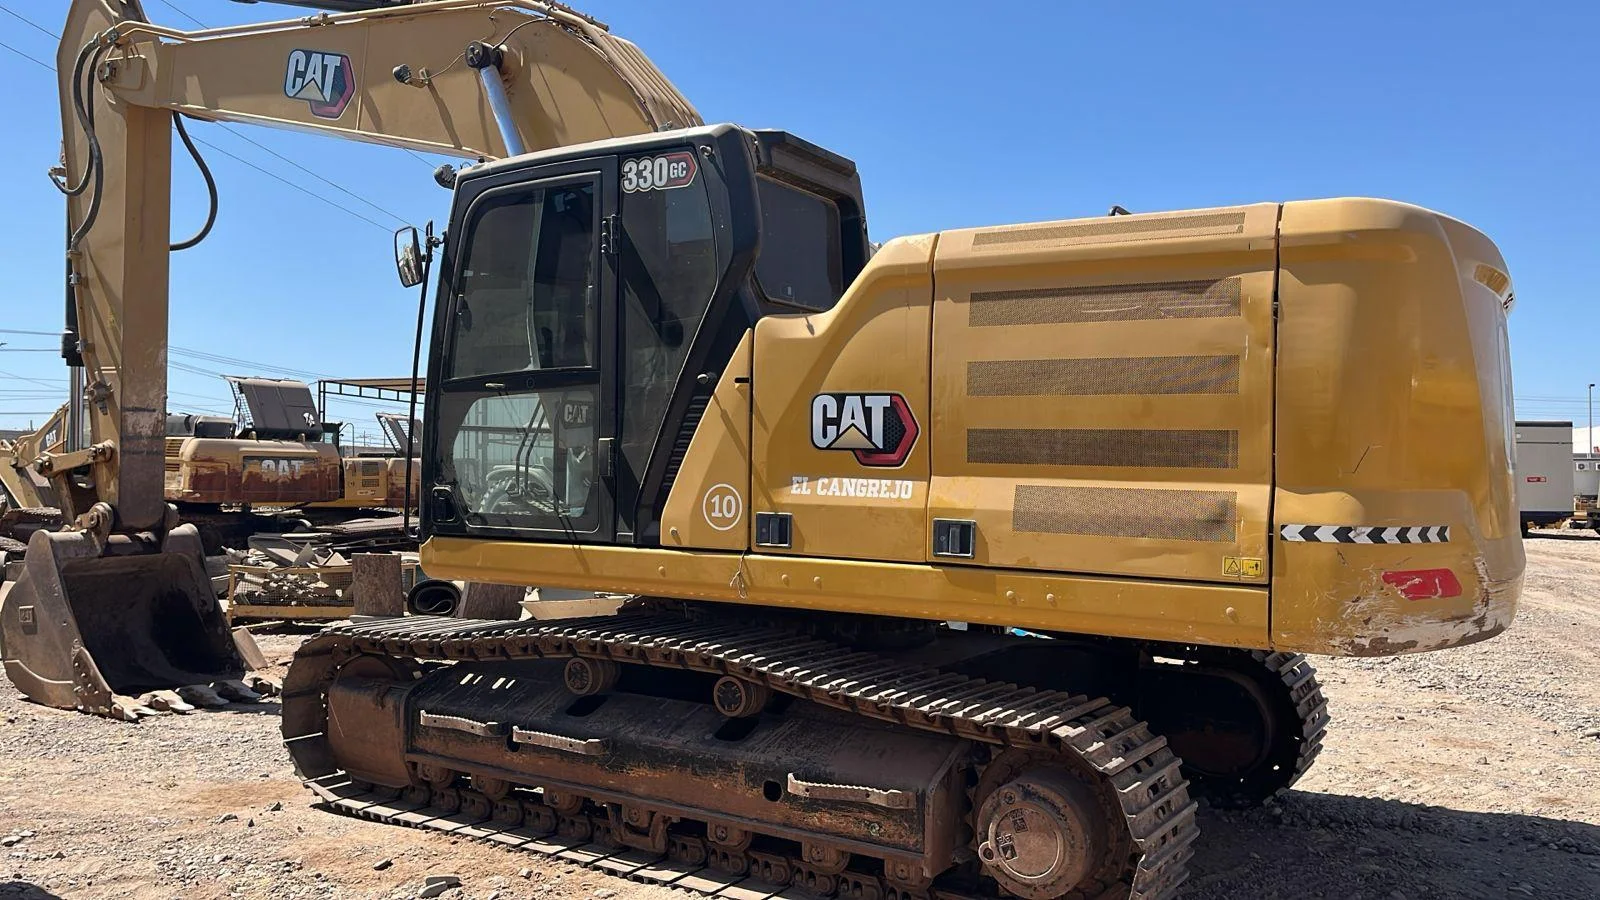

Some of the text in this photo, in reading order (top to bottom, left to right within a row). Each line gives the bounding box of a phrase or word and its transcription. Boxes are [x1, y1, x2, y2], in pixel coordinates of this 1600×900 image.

[285, 50, 342, 102] CAT
[564, 404, 589, 424] CAT
[812, 394, 891, 449] CAT
[790, 476, 913, 499] EL CANGREJO
[711, 494, 736, 518] 10
